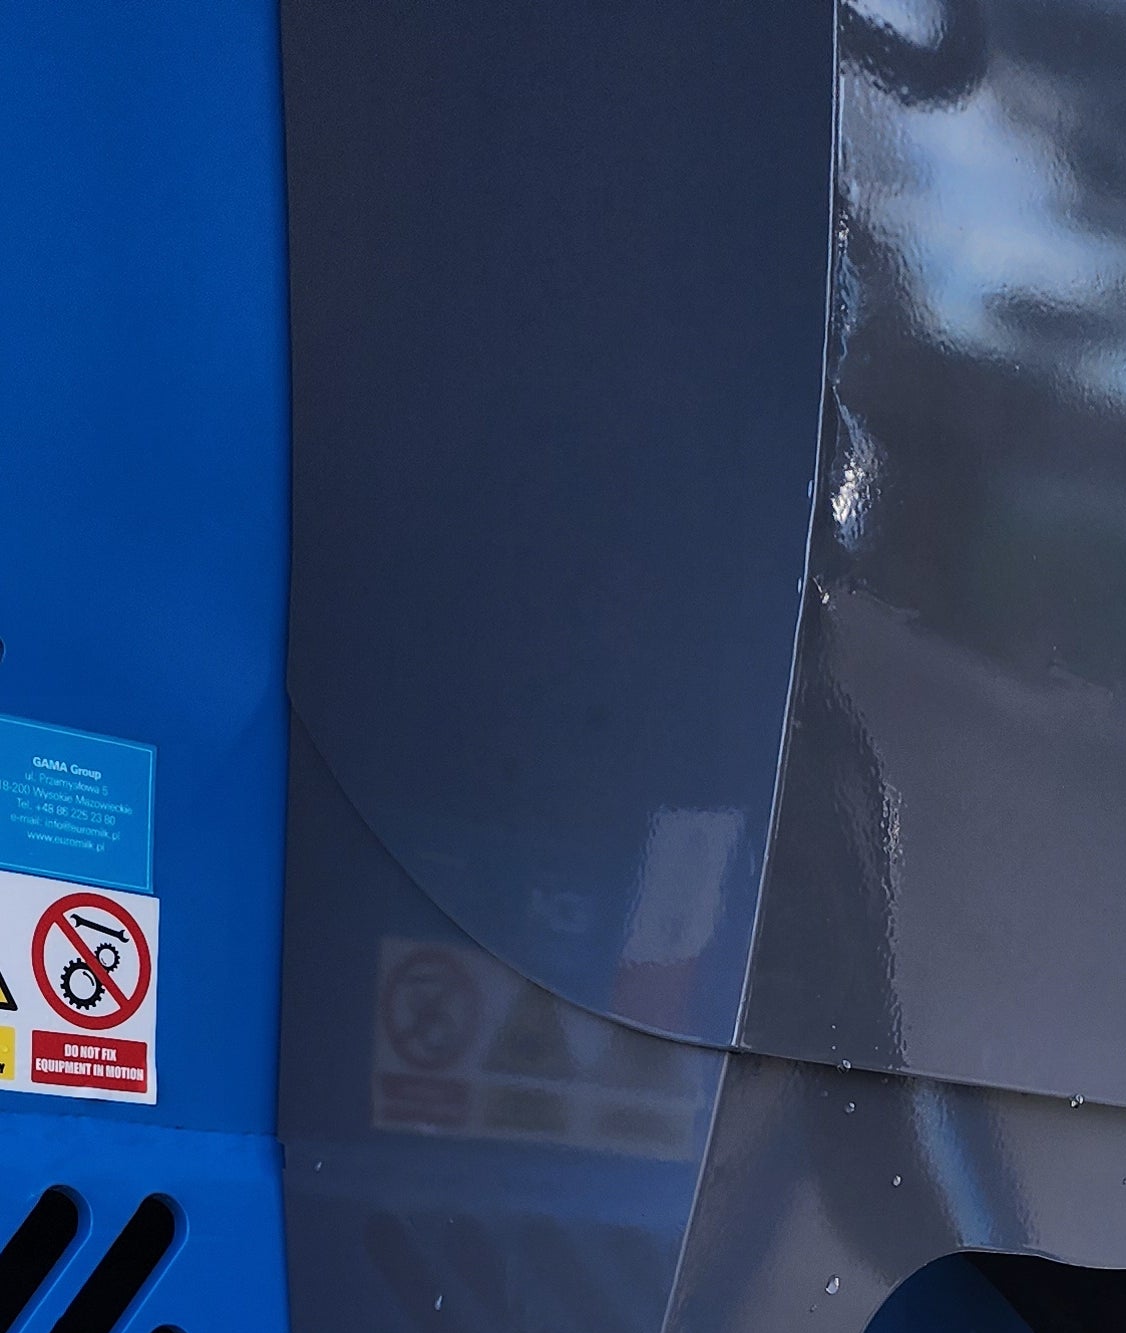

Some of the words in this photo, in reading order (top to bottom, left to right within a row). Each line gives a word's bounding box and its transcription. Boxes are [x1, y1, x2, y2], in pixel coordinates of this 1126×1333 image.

[33, 756, 68, 773] GAMA
[70, 764, 102, 781] Group
[33, 786, 73, 804] Wysokie
[102, 786, 109, 796] 5
[10, 812, 42, 826] e-mail:
[17, 797, 32, 810] Tel.
[35, 803, 54, 816] +48
[71, 807, 88, 821] 225
[90, 811, 102, 823] 23
[64, 1044, 77, 1057] DO
[80, 1046, 99, 1060] NOT
[101, 1048, 117, 1061] FIX
[36, 1058, 92, 1076] EQUIPMENT
[93, 1064, 104, 1077] IN
[106, 1065, 144, 1081] MOTION
